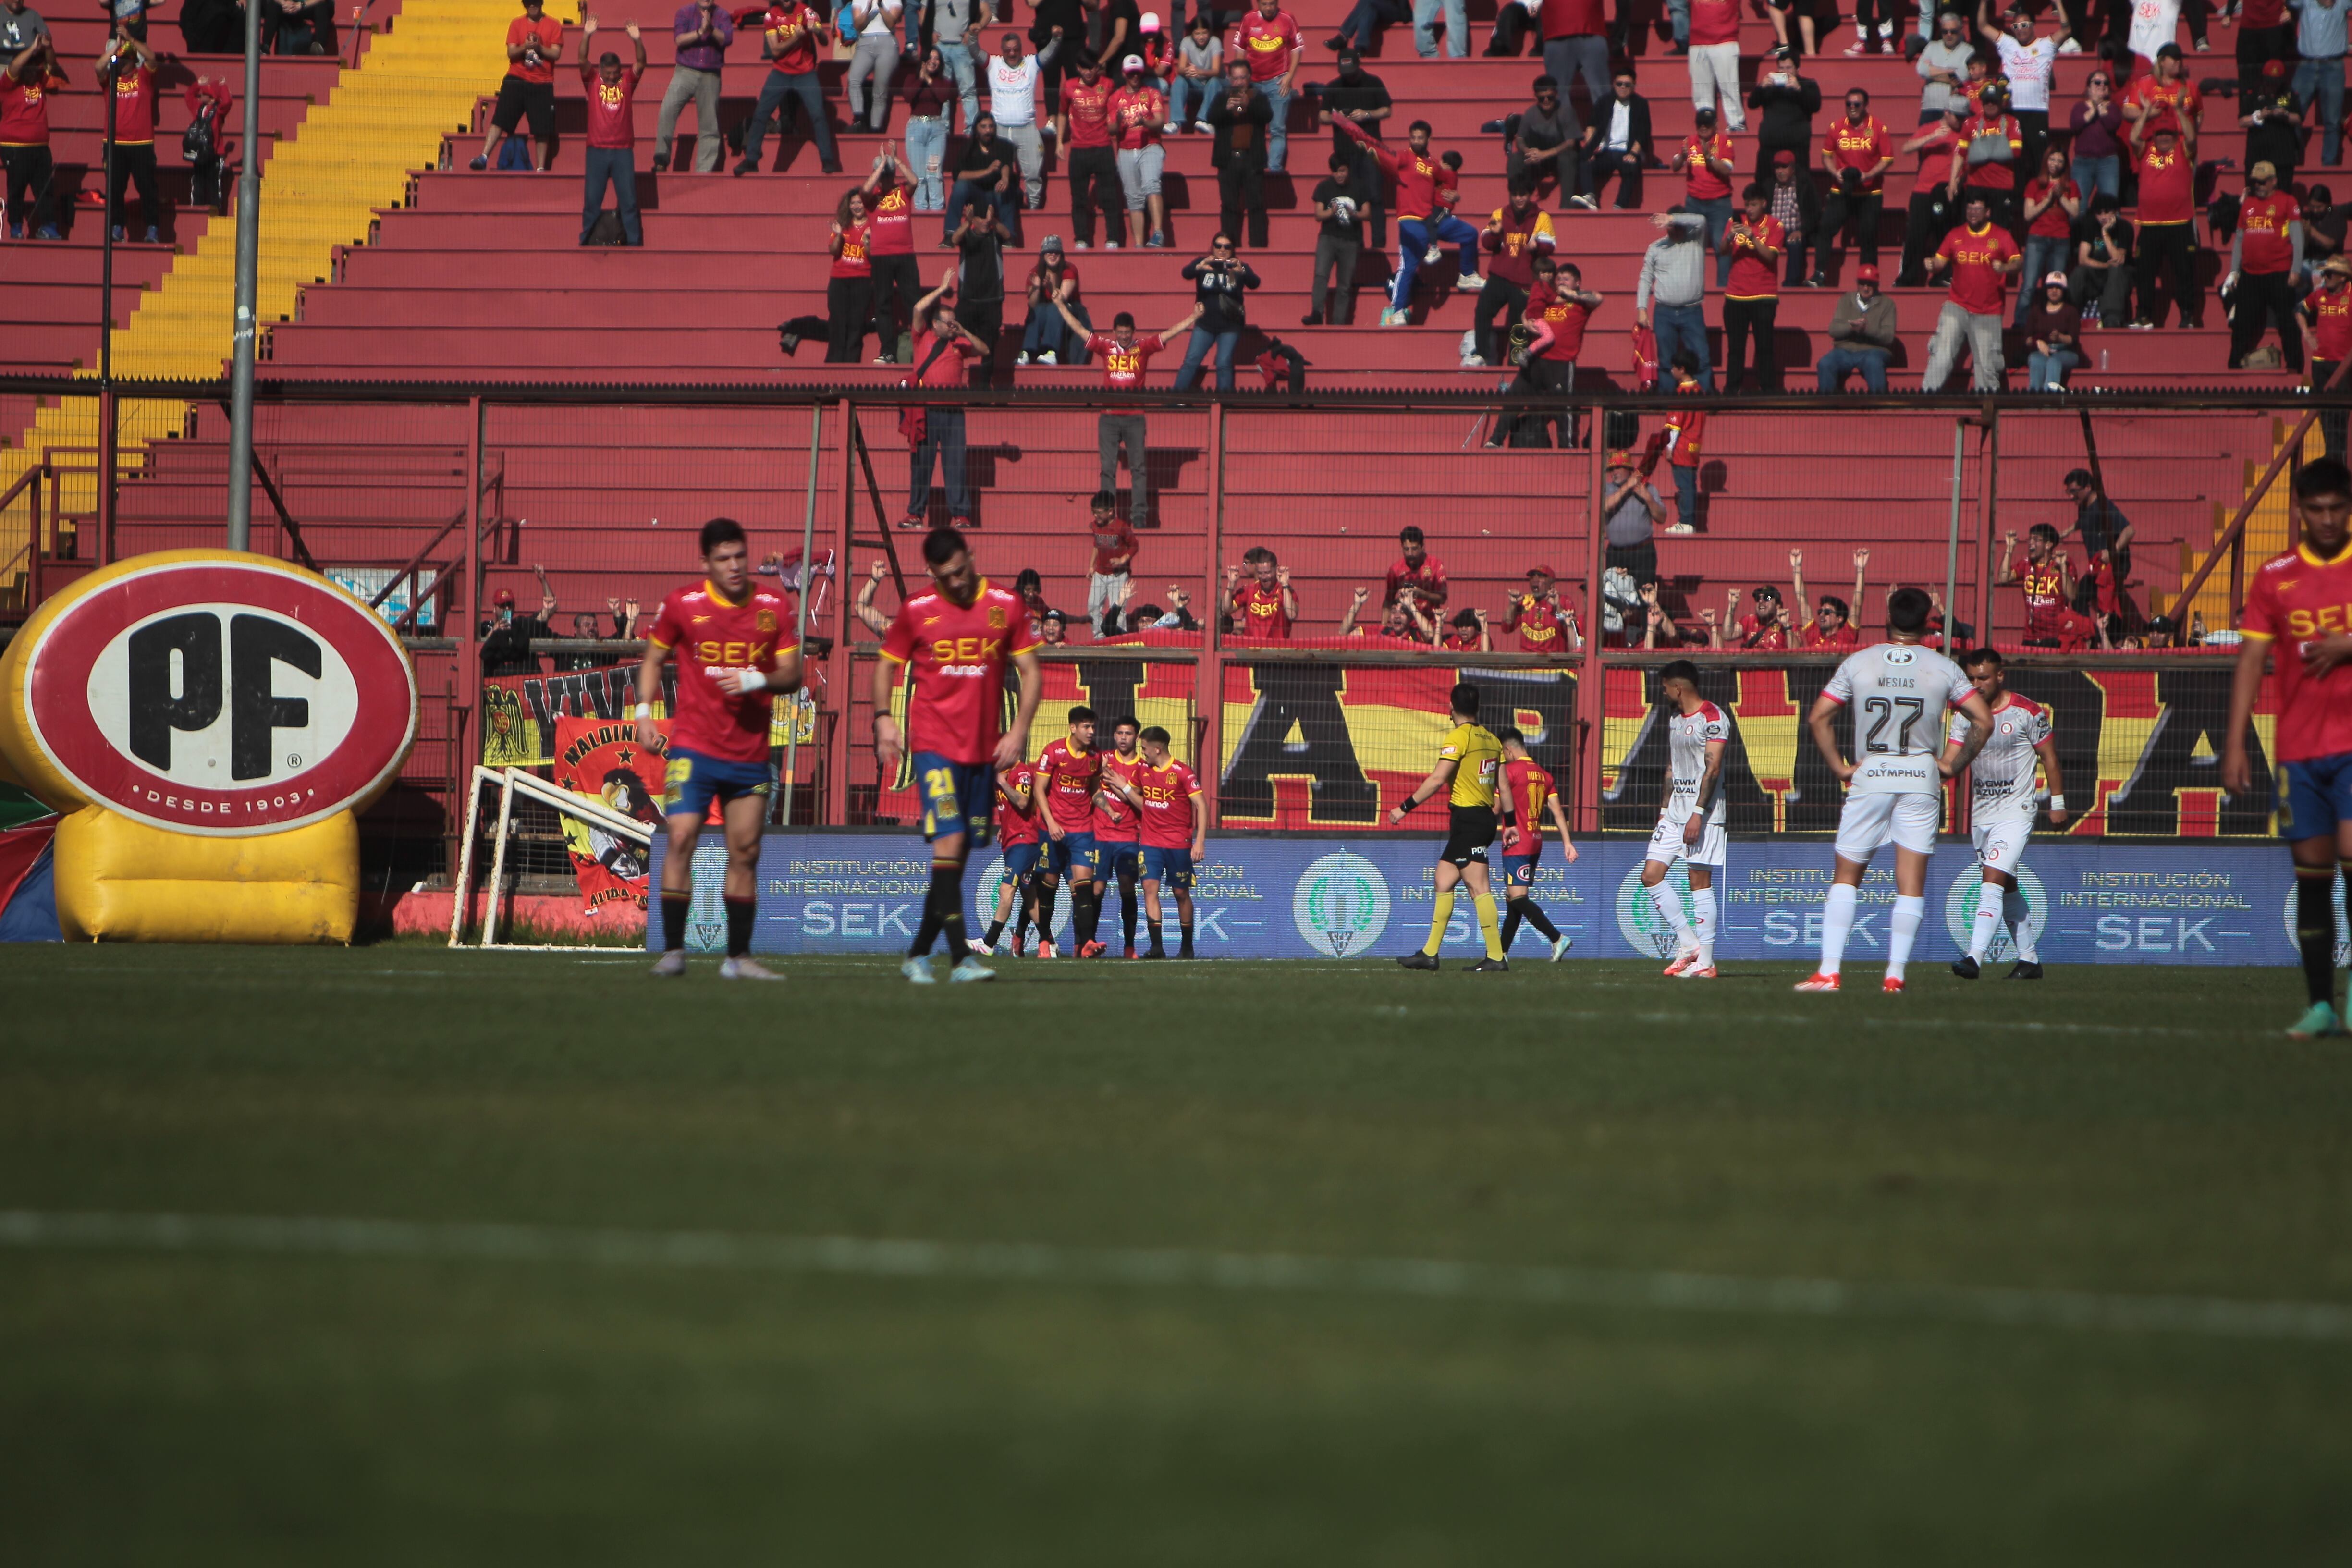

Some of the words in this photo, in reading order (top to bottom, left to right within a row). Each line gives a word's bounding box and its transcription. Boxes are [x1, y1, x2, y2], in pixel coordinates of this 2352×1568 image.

[1839, 137, 1872, 150] SEK
[879, 190, 903, 211] SEK
[2245, 216, 2273, 229] SEK
[843, 243, 864, 258] SEK
[1957, 250, 1991, 265] SEK
[2320, 305, 2349, 316] SEK
[1107, 354, 1140, 370] SEK
[1109, 370, 1135, 380] starken
[2024, 574, 2058, 595] SEK
[1250, 602, 1278, 616] SEK
[700, 641, 769, 663] SEK
[931, 638, 1001, 662] SEK
[1878, 677, 1915, 688] MESIAS
[128, 611, 322, 781] PF
[1865, 696, 1925, 754] 27
[925, 767, 955, 797] 21
[1867, 769, 1926, 778] OLYMPHUS
[147, 789, 231, 814] DESDE
[245, 792, 301, 813] 1903
[1143, 786, 1176, 800] SEK
[789, 857, 927, 876] INSTITUCIÓN
[770, 879, 931, 895] INTERNACIONA
[2082, 868, 2230, 888] INSTITUCIÓN
[2060, 891, 2252, 909] INTERNACIONAL
[803, 900, 912, 937] SEK
[2095, 914, 2216, 952] SEK
